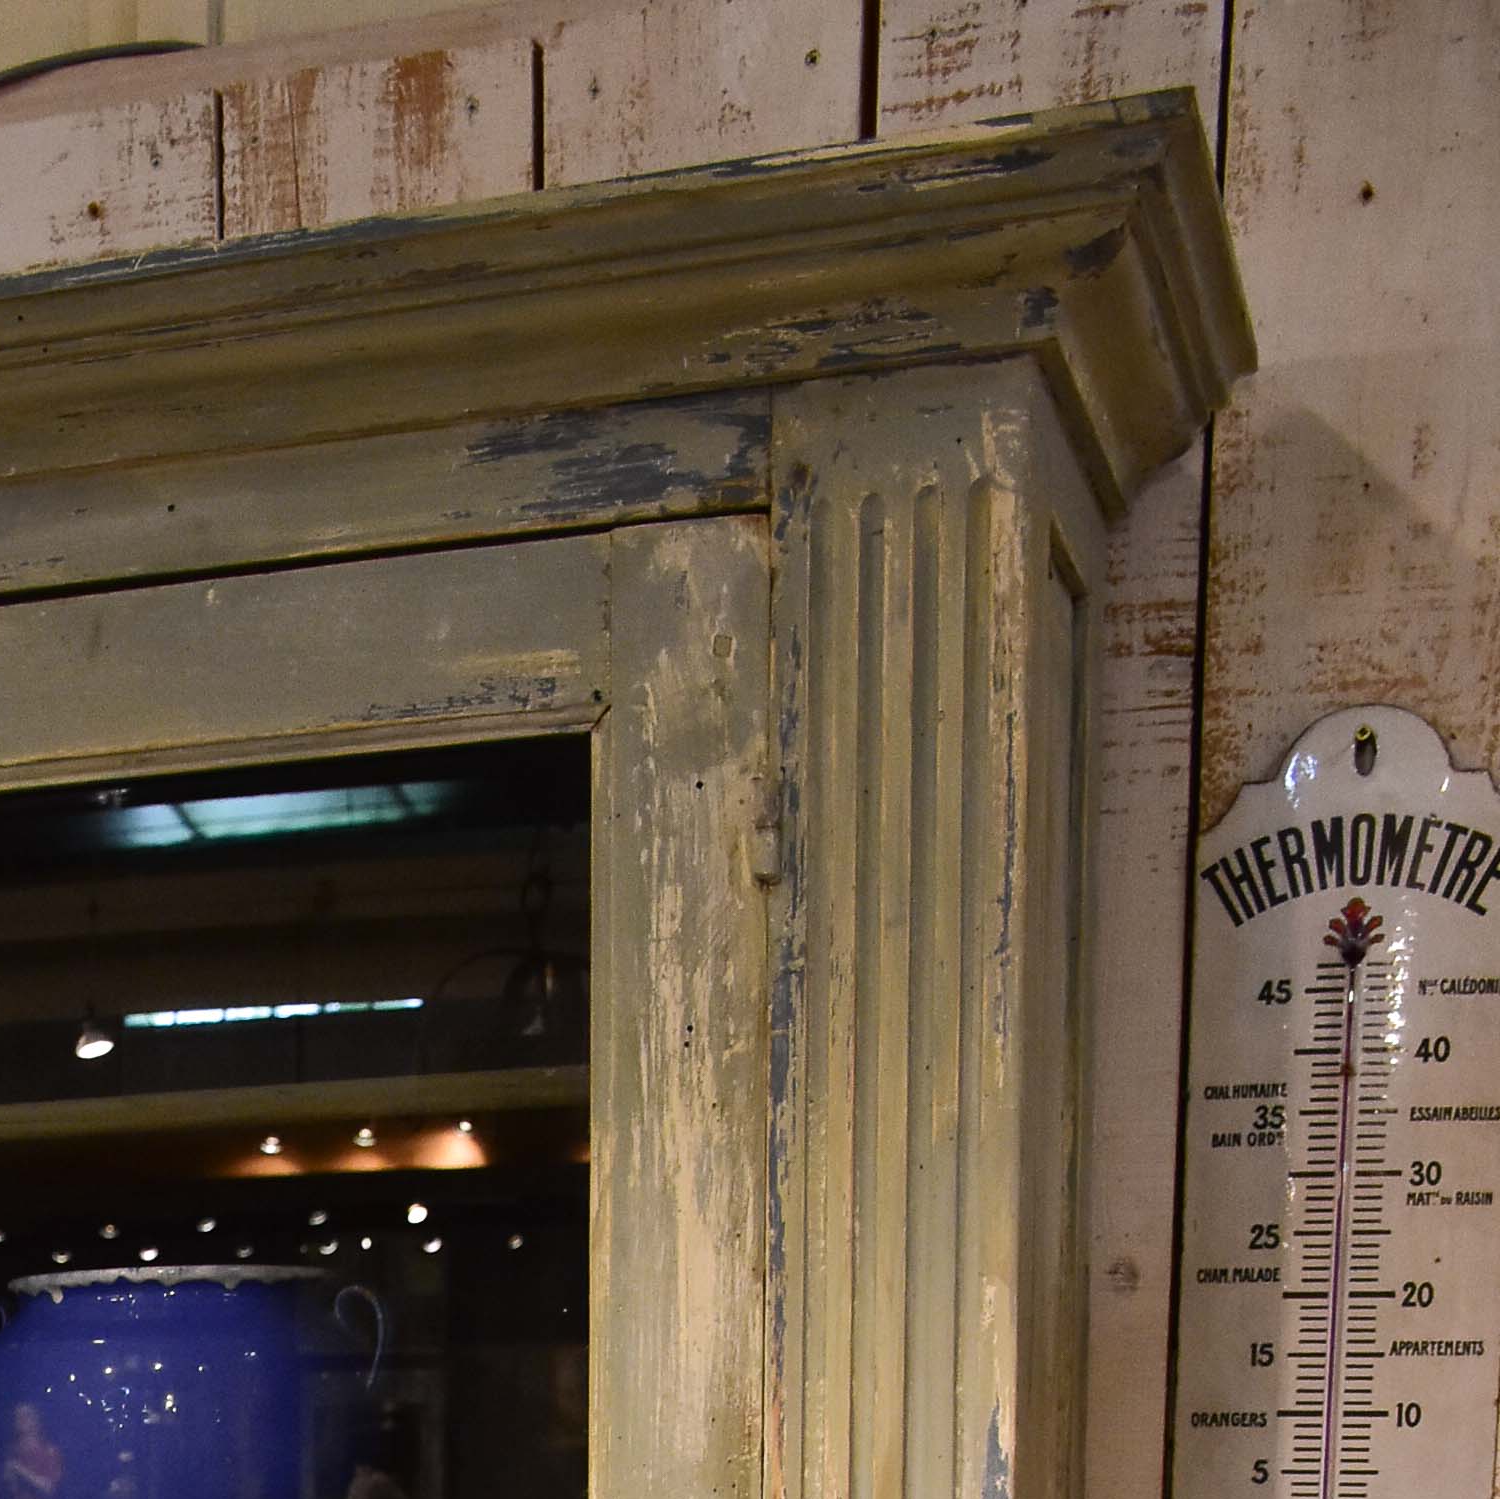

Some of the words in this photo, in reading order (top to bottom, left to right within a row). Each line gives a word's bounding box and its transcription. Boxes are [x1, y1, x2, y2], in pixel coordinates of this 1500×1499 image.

[1200, 813, 1500, 927] THERMOMÈTRE
[1258, 980, 1292, 1005] 45
[1440, 976, 1500, 995] CALÉDONI
[1415, 1037, 1450, 1062] 40
[1253, 1105, 1285, 1129] 35
[1212, 1133, 1241, 1148] BAIN
[1409, 1161, 1442, 1186] 30
[1455, 1191, 1493, 1205] RAISIN
[1249, 1224, 1280, 1250] 25
[1233, 1267, 1281, 1282] MALADE
[1401, 1282, 1434, 1307] 20
[1250, 1343, 1274, 1367] 15
[1389, 1340, 1485, 1357] APPARTEMENTS
[1191, 1412, 1268, 1428] ORANGERS
[1396, 1402, 1422, 1428] 10
[1251, 1460, 1269, 1484] 5
